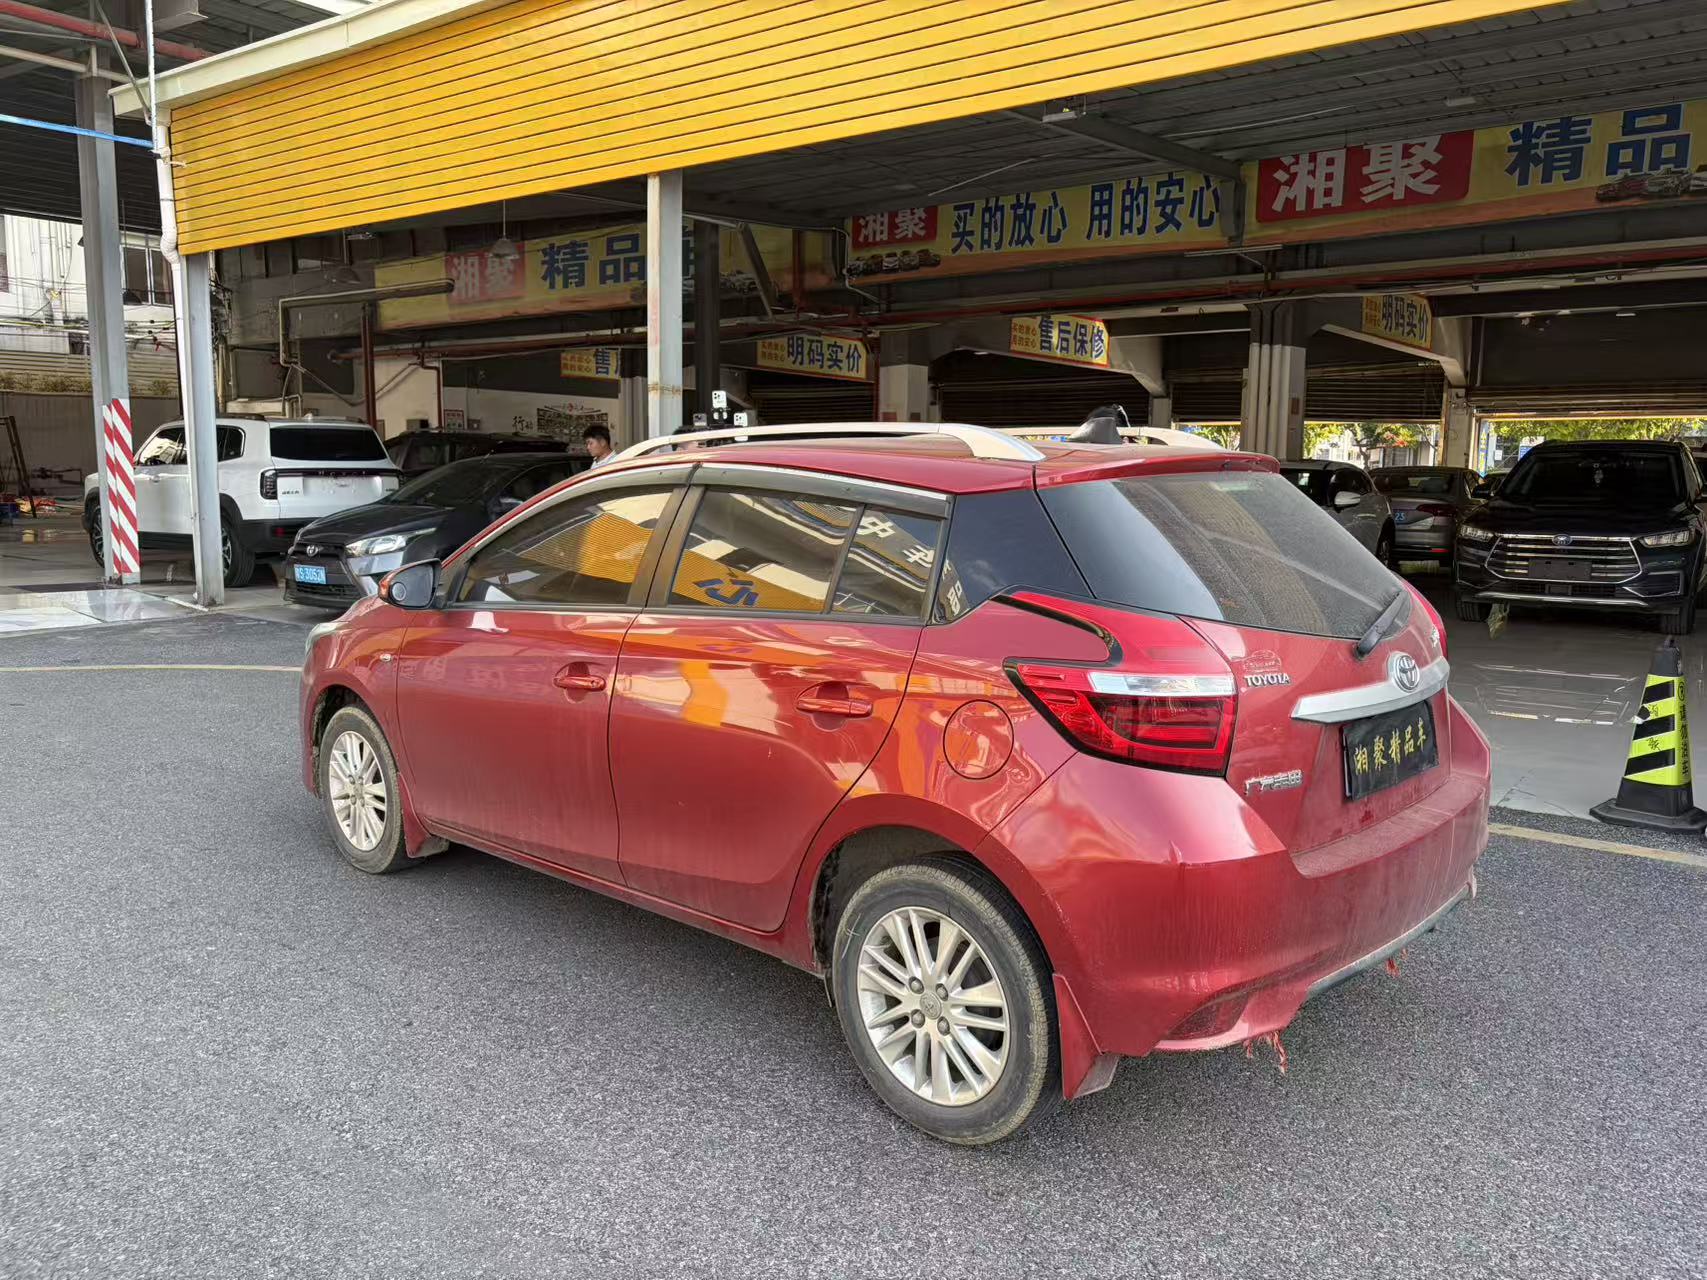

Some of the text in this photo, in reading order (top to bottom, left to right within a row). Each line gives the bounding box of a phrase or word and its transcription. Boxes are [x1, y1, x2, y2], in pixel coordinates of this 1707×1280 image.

[1272, 103, 1692, 212] 湘聚 精品
[858, 172, 1221, 254] 湘聚 买的放心 用的安心
[452, 254, 516, 300] 湘聚
[539, 232, 647, 290] 精品
[1040, 315, 1105, 359] 售后保修
[1382, 294, 1429, 344] 明码实价
[787, 335, 862, 374] 明码实价
[1245, 672, 1291, 687] TOYOTA
[1354, 717, 1427, 775] 湘聚精品车
